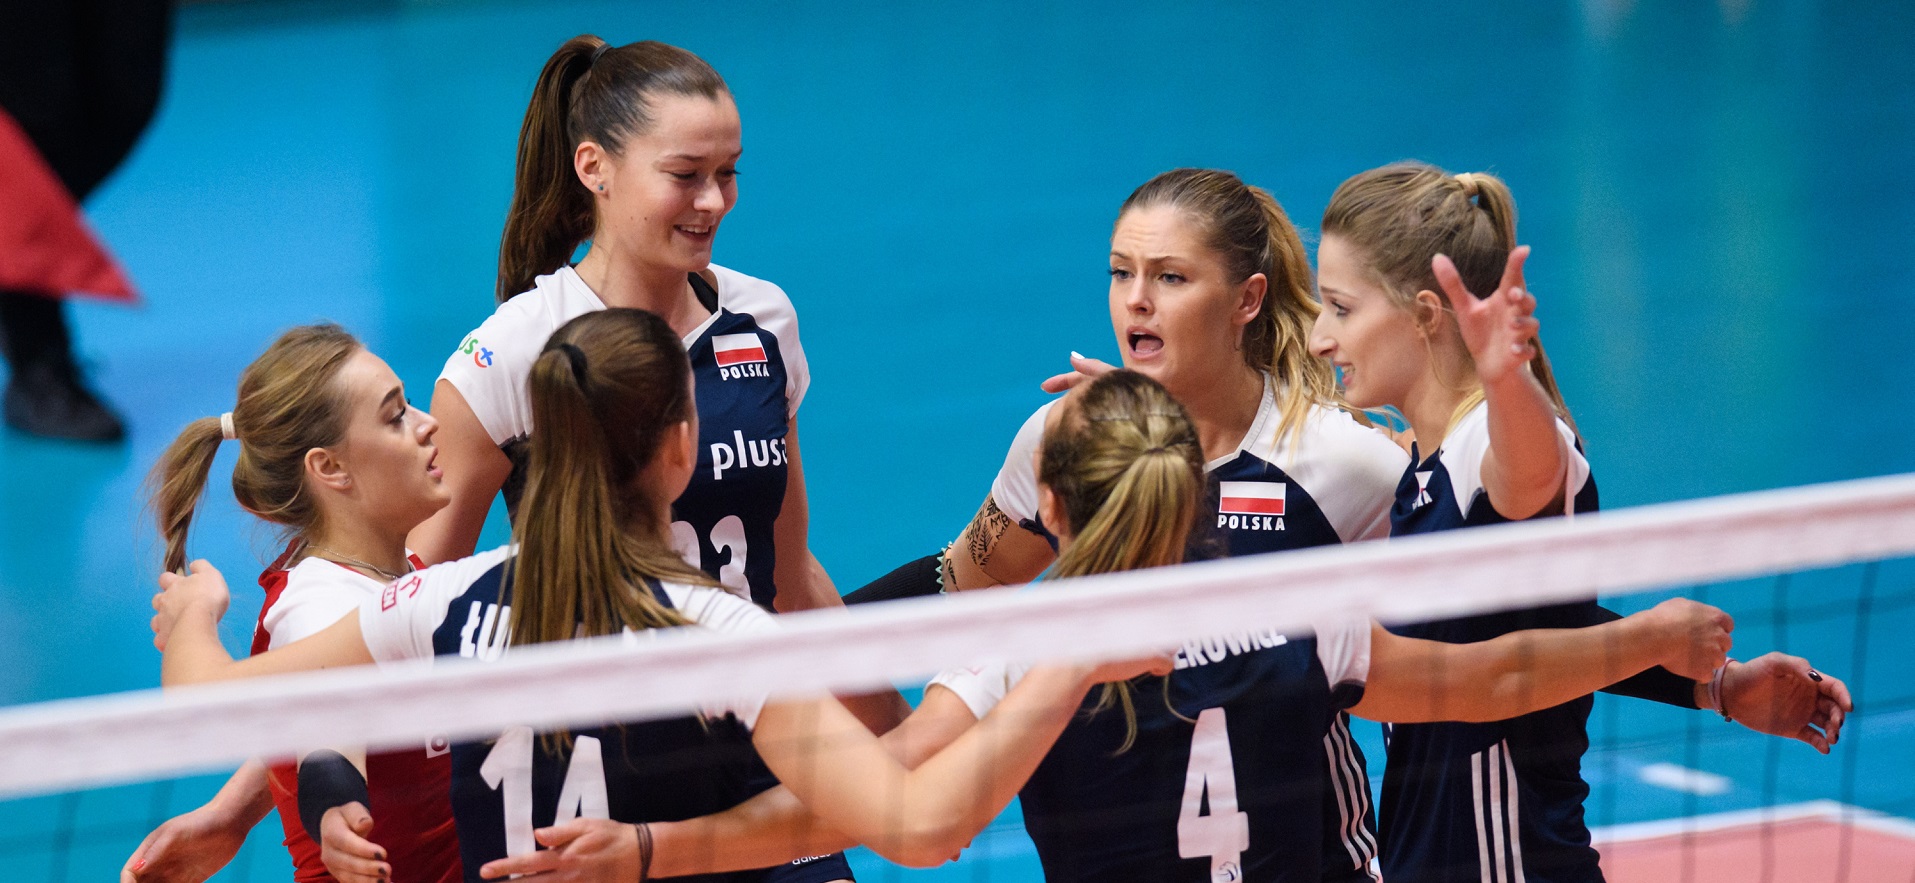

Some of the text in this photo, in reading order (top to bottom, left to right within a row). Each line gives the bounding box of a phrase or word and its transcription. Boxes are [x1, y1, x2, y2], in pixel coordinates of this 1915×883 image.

[720, 363, 770, 381] POLSKA
[1217, 514, 1286, 531] POLSKA
[670, 514, 753, 602] 3
[1177, 706, 1250, 883] 4
